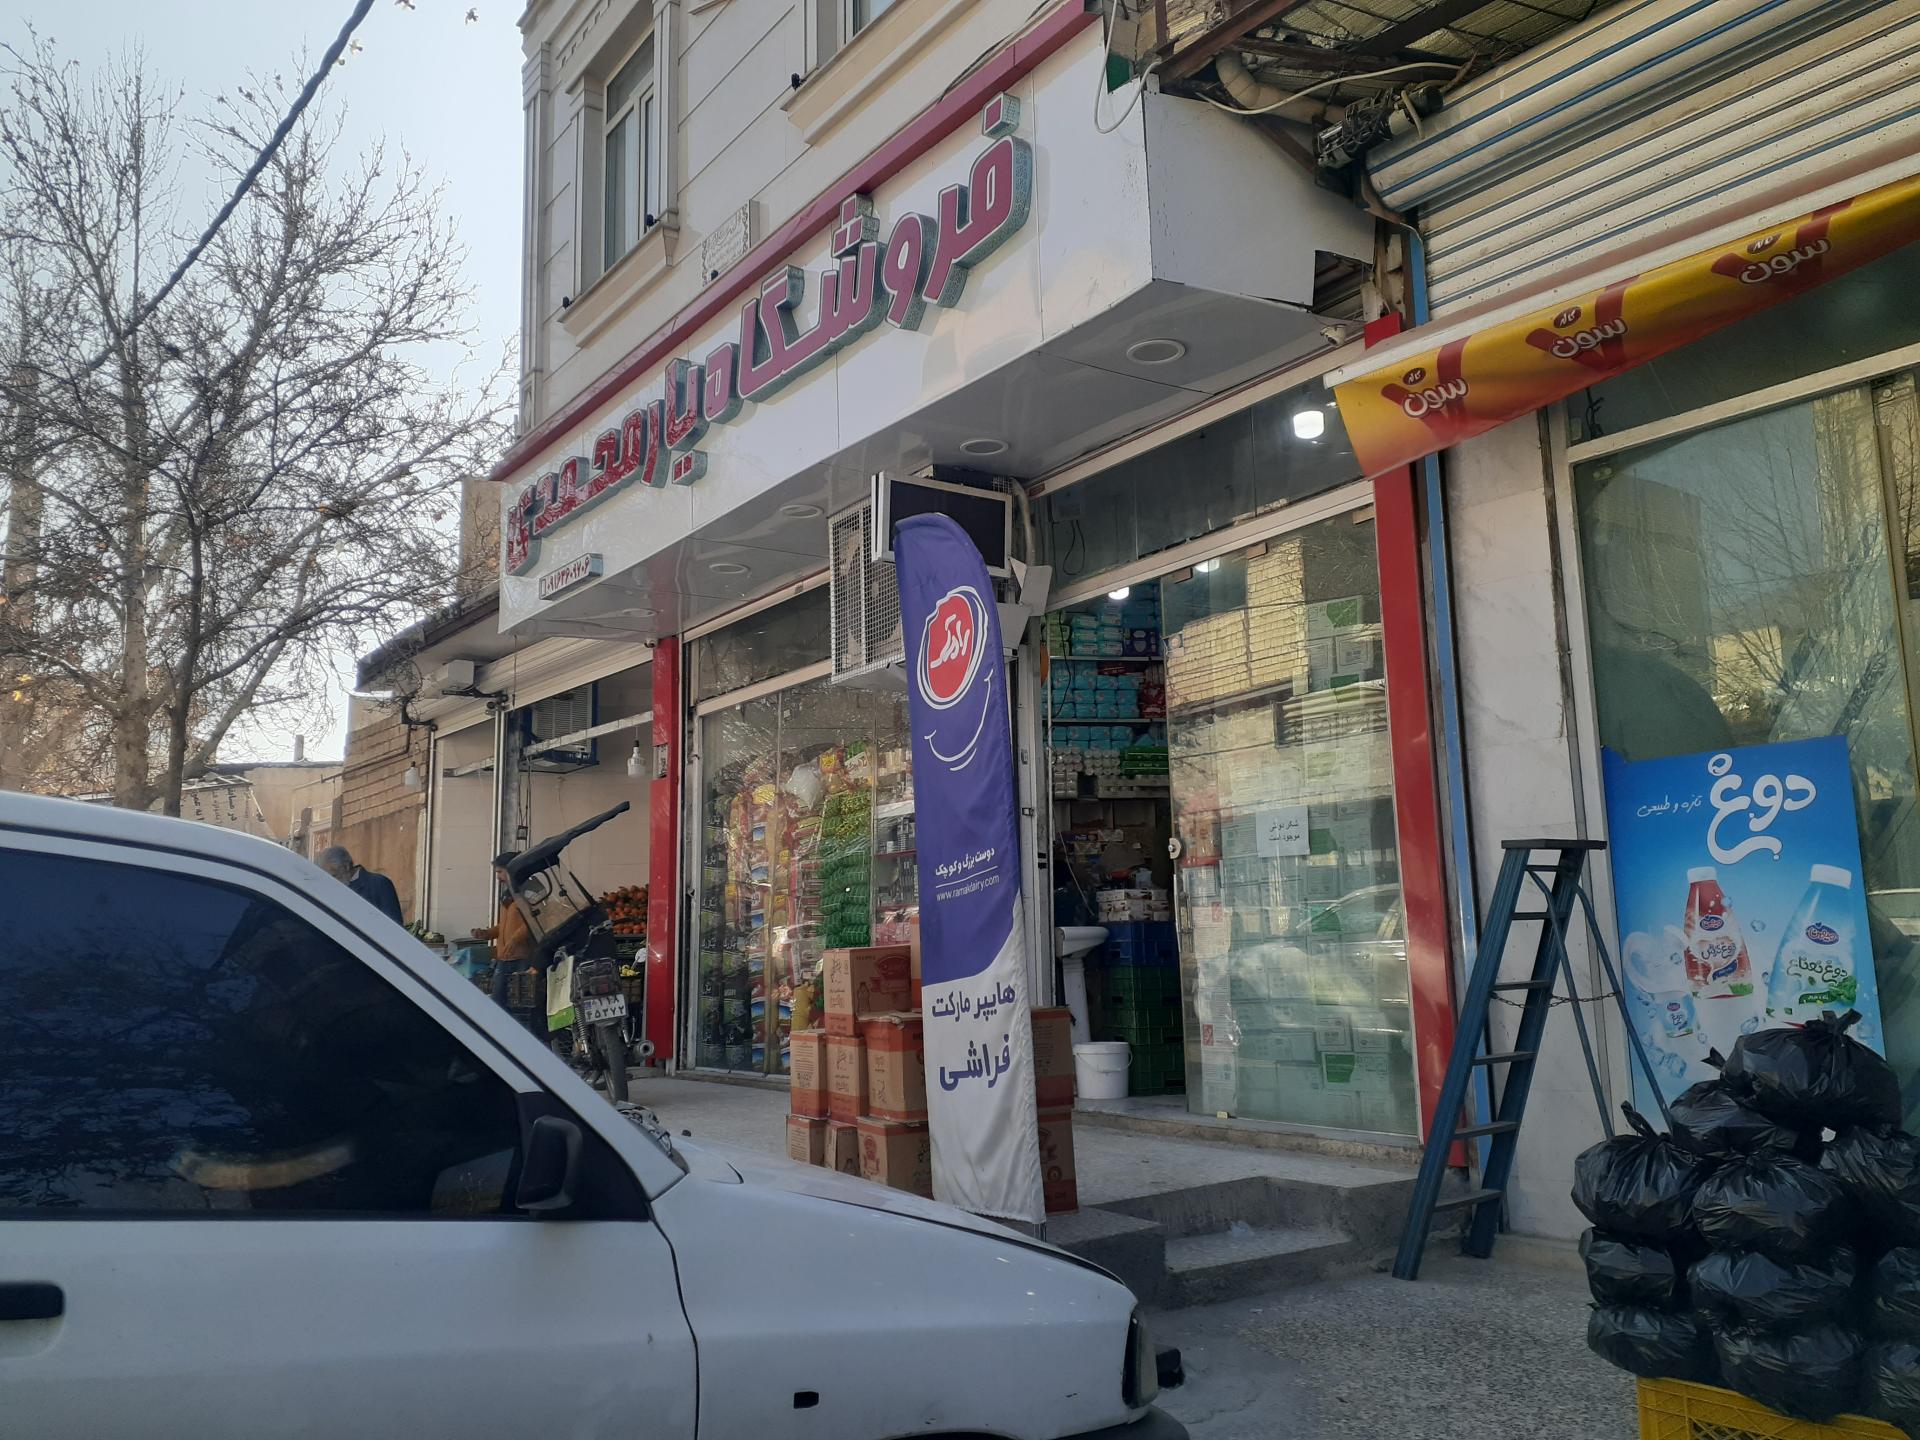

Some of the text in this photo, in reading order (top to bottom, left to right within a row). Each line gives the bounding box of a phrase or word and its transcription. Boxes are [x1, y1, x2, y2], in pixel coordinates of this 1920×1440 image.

[1740, 238, 1829, 283] سون
[505, 92, 1022, 575] فروشگاه یارمحمدی
[1552, 318, 1626, 358] سون
[1404, 378, 1467, 416] سون
[1637, 794, 1703, 817] تازه و طبیعی
[1707, 753, 1817, 865] دوغ
[1282, 833, 1300, 841] موجود
[1286, 820, 1299, 830] شکر
[935, 847, 995, 879] دوست بزرگ و کوچک
[936, 875, 1000, 901] www.ramakdairy.com
[1822, 959, 1848, 985] دوغ
[932, 982, 1016, 1022] هایپر مارکت
[939, 1033, 1011, 1091] فراشی
